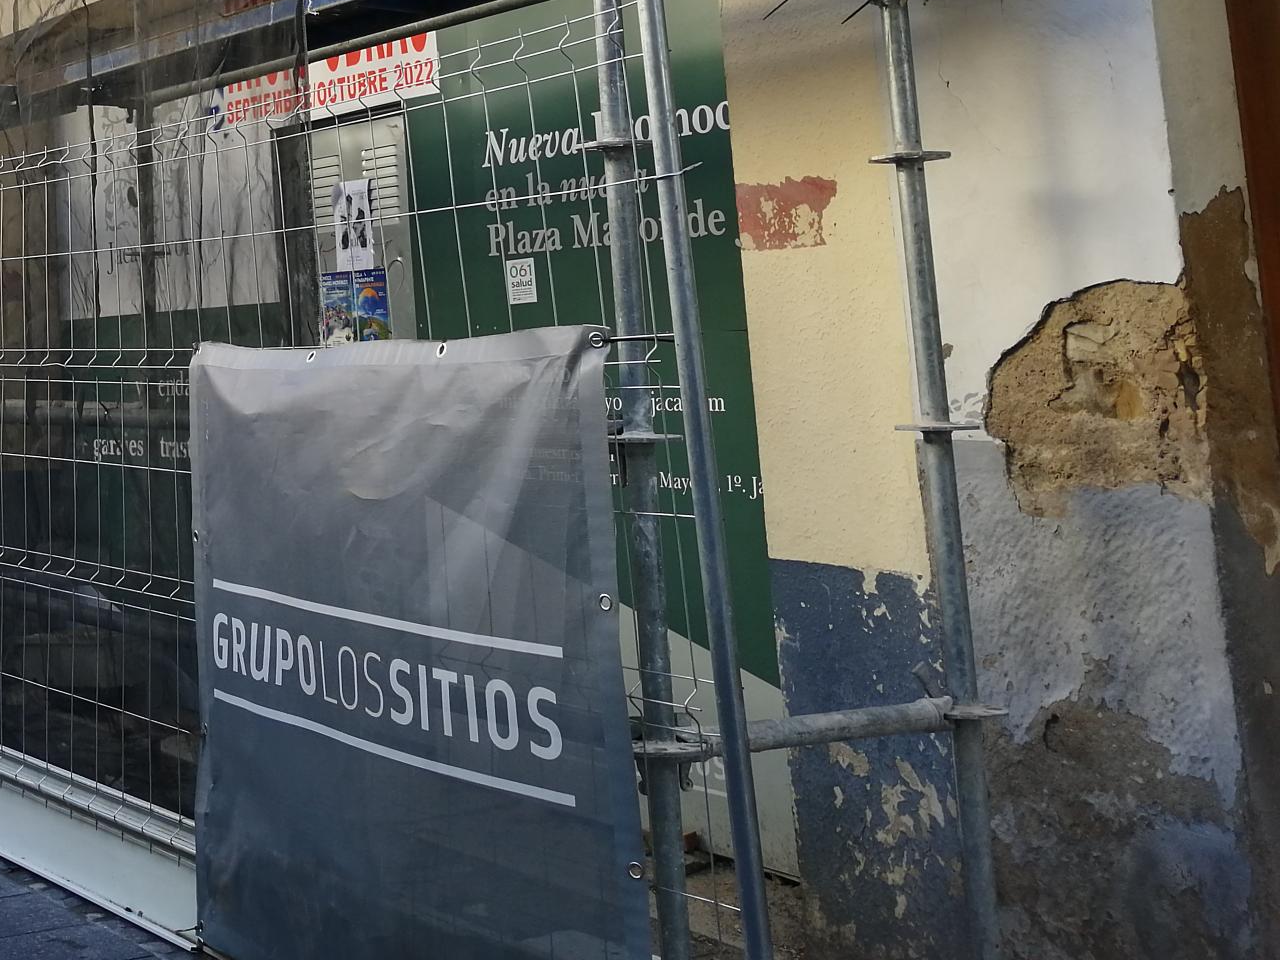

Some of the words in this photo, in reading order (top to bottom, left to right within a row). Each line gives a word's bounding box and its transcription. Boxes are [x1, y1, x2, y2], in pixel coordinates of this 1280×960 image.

[394, 58, 433, 90] 2022
[482, 127, 580, 168] Nueva
[485, 186, 518, 212] en
[526, 172, 552, 207] la
[560, 168, 650, 203] nua
[487, 221, 562, 257] Plaza
[570, 212, 662, 249] Mao
[688, 199, 726, 238] de
[510, 263, 532, 279] 061
[511, 278, 533, 289] salud
[213, 612, 563, 760] GRUPOLOSSITIOS
